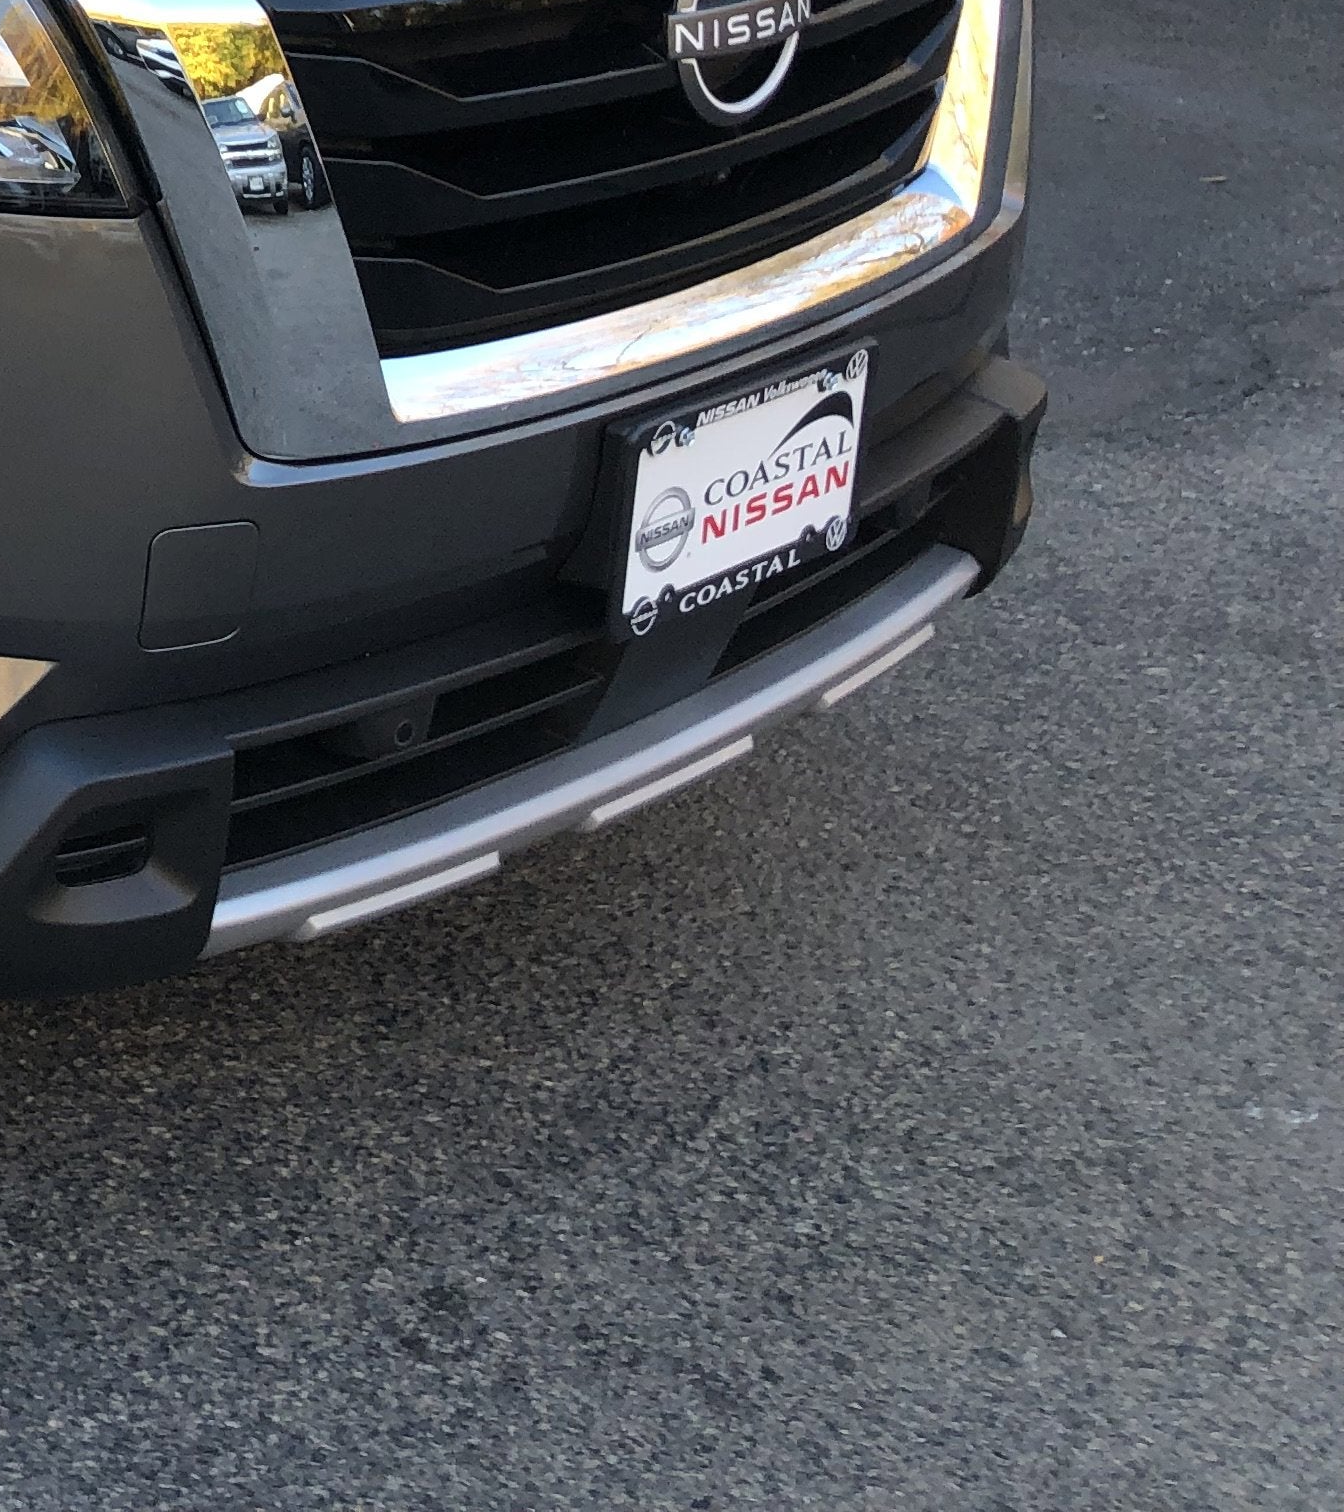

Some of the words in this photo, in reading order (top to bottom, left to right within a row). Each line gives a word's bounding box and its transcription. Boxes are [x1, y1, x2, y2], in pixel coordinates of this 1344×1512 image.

[696, 392, 761, 428] NISSAN
[704, 430, 852, 506] COASTAL
[639, 515, 690, 544] NISSAN
[702, 461, 849, 544] NISSAN
[679, 548, 801, 613] COASTAL
